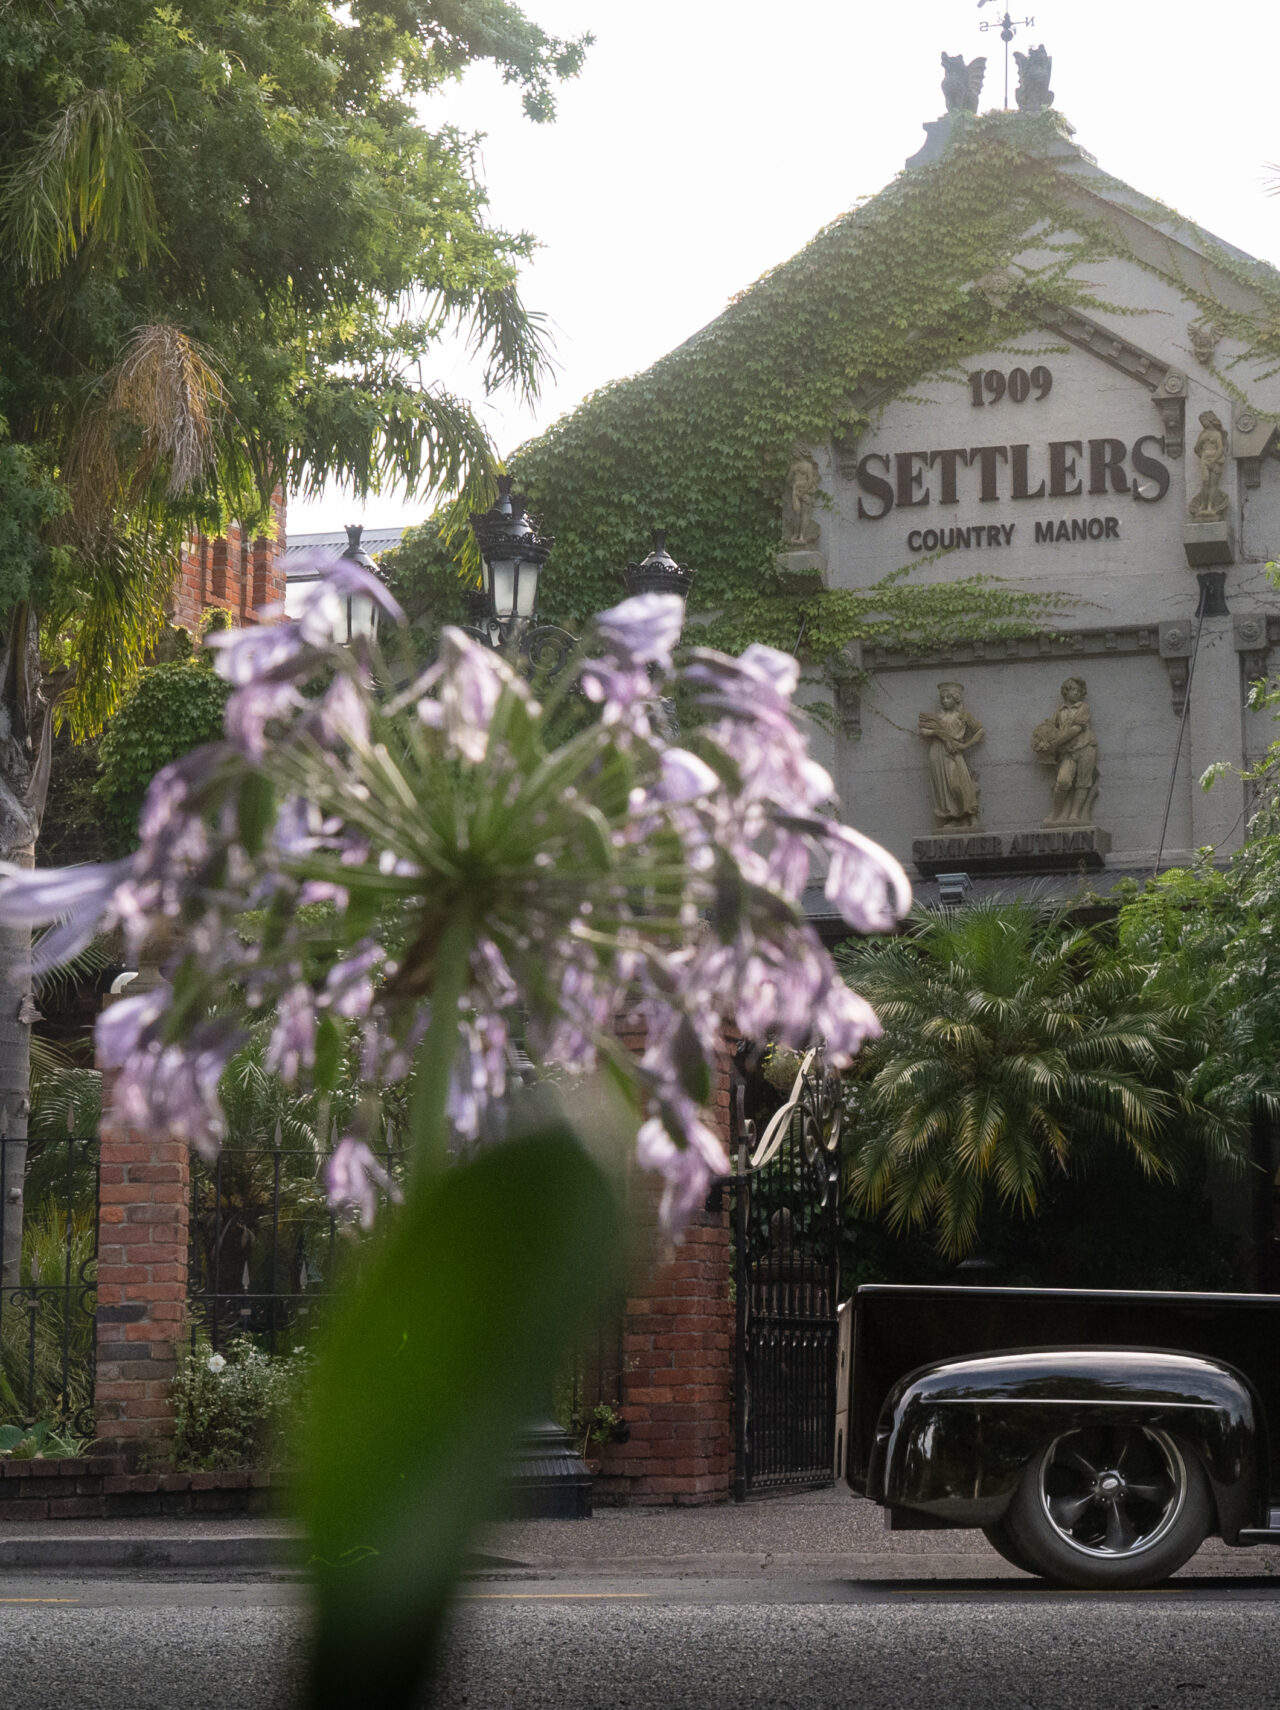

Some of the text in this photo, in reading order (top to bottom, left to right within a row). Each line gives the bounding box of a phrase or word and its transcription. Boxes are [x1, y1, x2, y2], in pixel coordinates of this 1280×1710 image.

[969, 365, 1053, 407] 1909
[857, 435, 1170, 519] SETTLERS
[907, 516, 1120, 552] COUNTRY MANOR
[913, 831, 1096, 859] SUMMER AUTUMN
